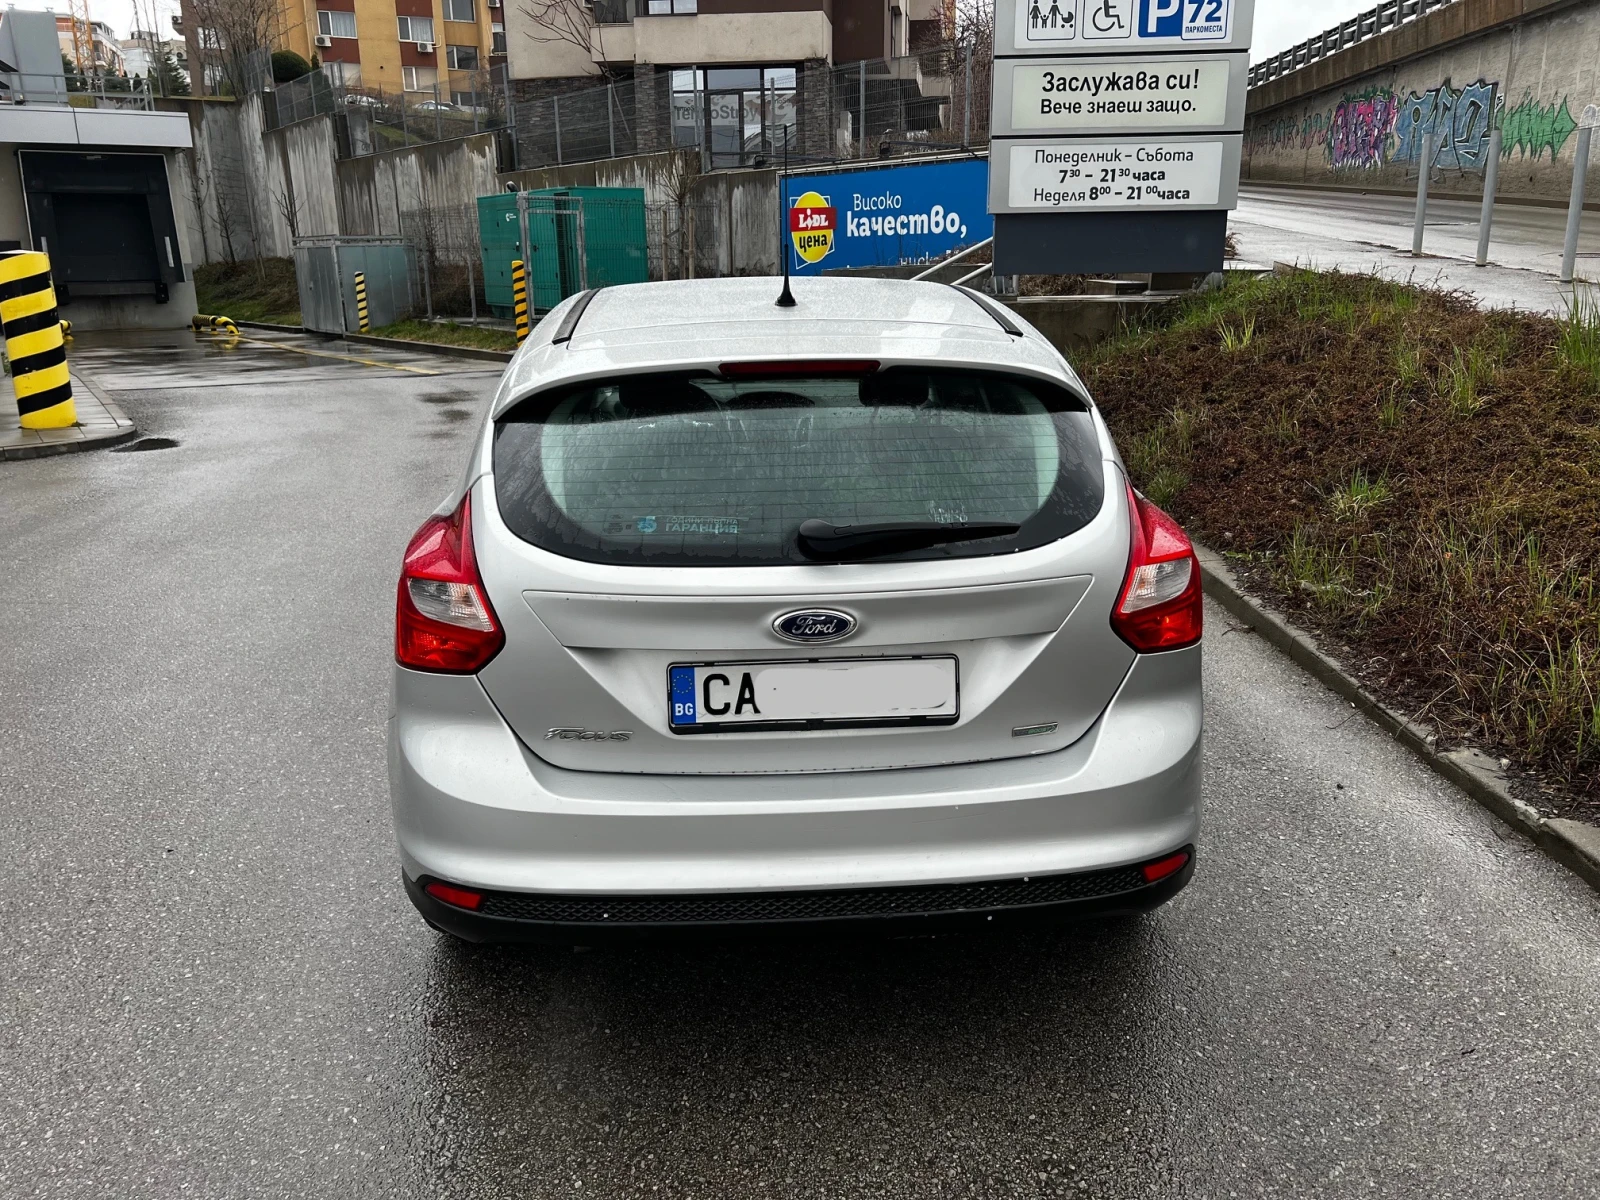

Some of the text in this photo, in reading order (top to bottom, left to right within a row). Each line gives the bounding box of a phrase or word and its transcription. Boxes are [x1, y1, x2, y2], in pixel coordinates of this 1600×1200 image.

[1186, 0, 1223, 24] 72
[1184, 25, 1223, 34] ПАРКОМЕСТА
[1042, 68, 1200, 97] Заслужава си!
[1040, 99, 1197, 115] Вече знаеш защо.
[1034, 148, 1122, 167] Понеделник
[1136, 147, 1194, 162] Събота
[1132, 170, 1166, 182] часа
[853, 191, 902, 211] Високо
[1034, 187, 1086, 206] Неделя
[1157, 188, 1191, 200] часа
[846, 204, 968, 239] качество,
[799, 233, 828, 253] цена
[665, 523, 738, 534] ГАРАНЦИЯ
[791, 616, 838, 635] Ford
[702, 672, 761, 716] CA
[674, 702, 694, 716] BG
